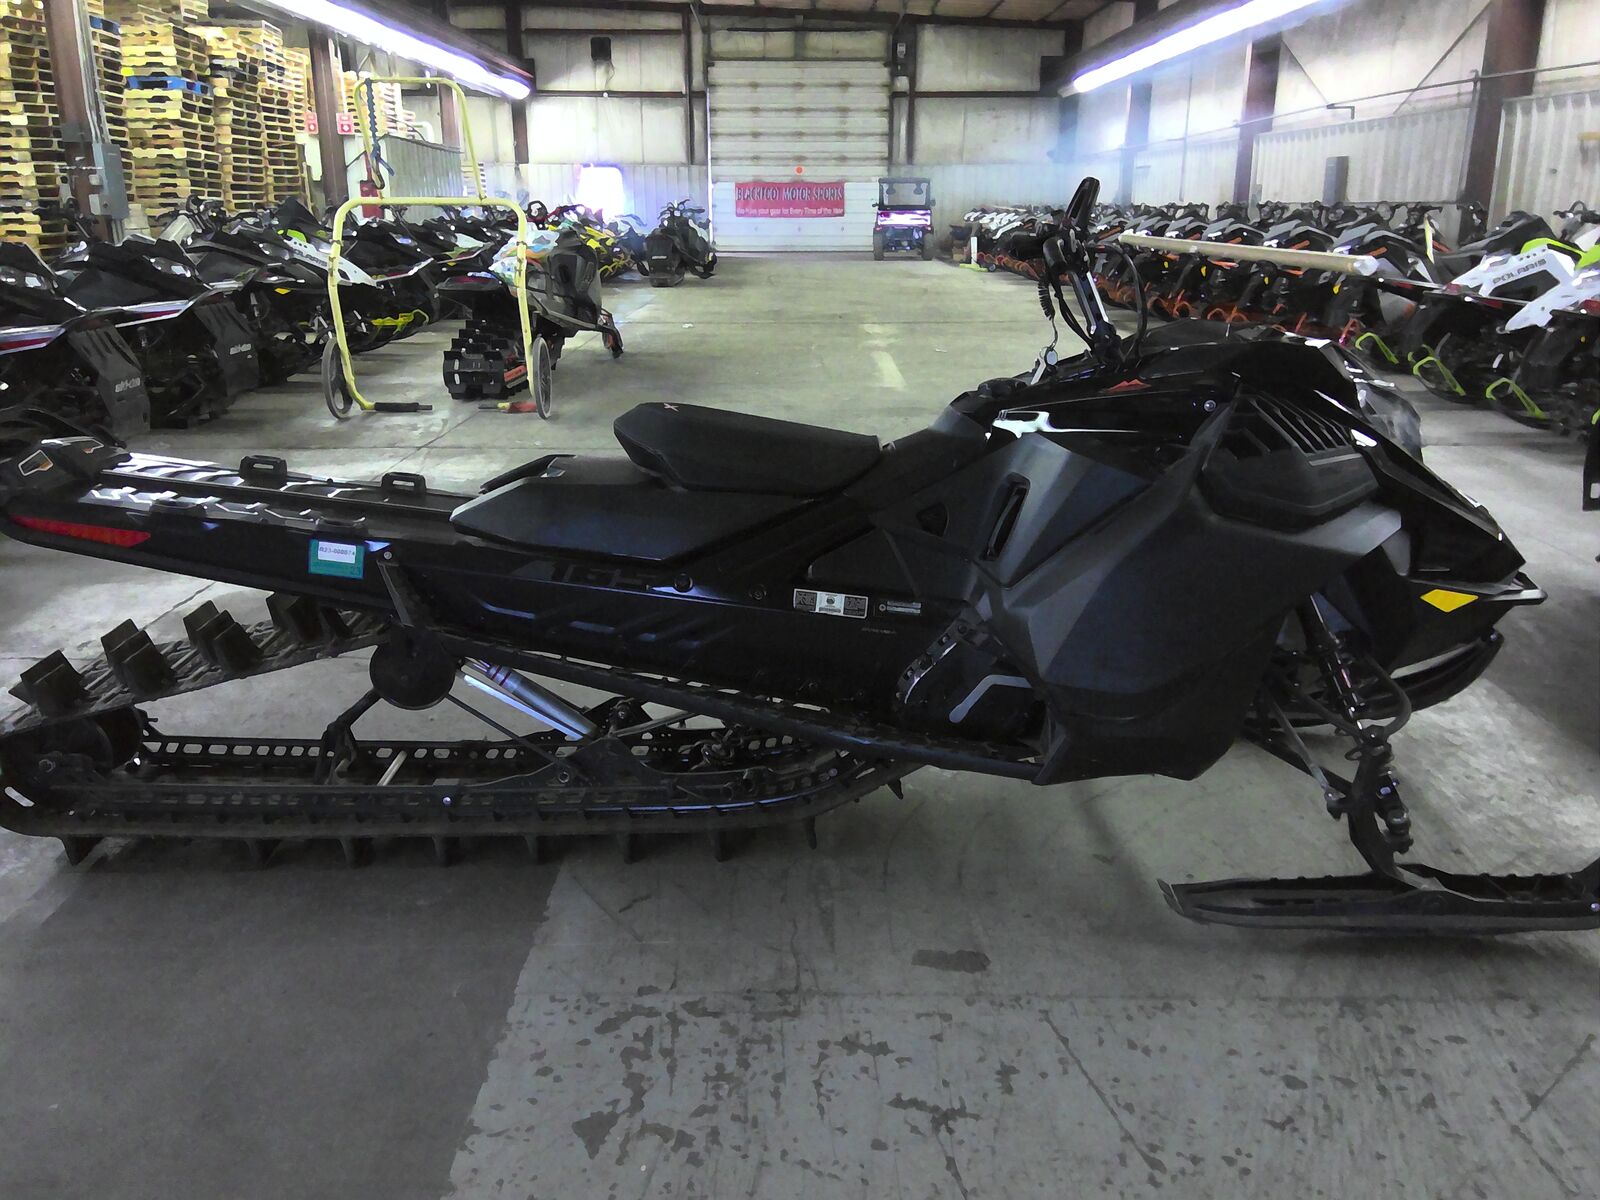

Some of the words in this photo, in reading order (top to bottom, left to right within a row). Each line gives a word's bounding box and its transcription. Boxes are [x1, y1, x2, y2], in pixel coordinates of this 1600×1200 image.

[783, 187, 811, 201] MOTOR
[813, 187, 844, 201] SPORTS
[290, 248, 328, 267] OLARIS
[1492, 258, 1547, 284] POLARIS
